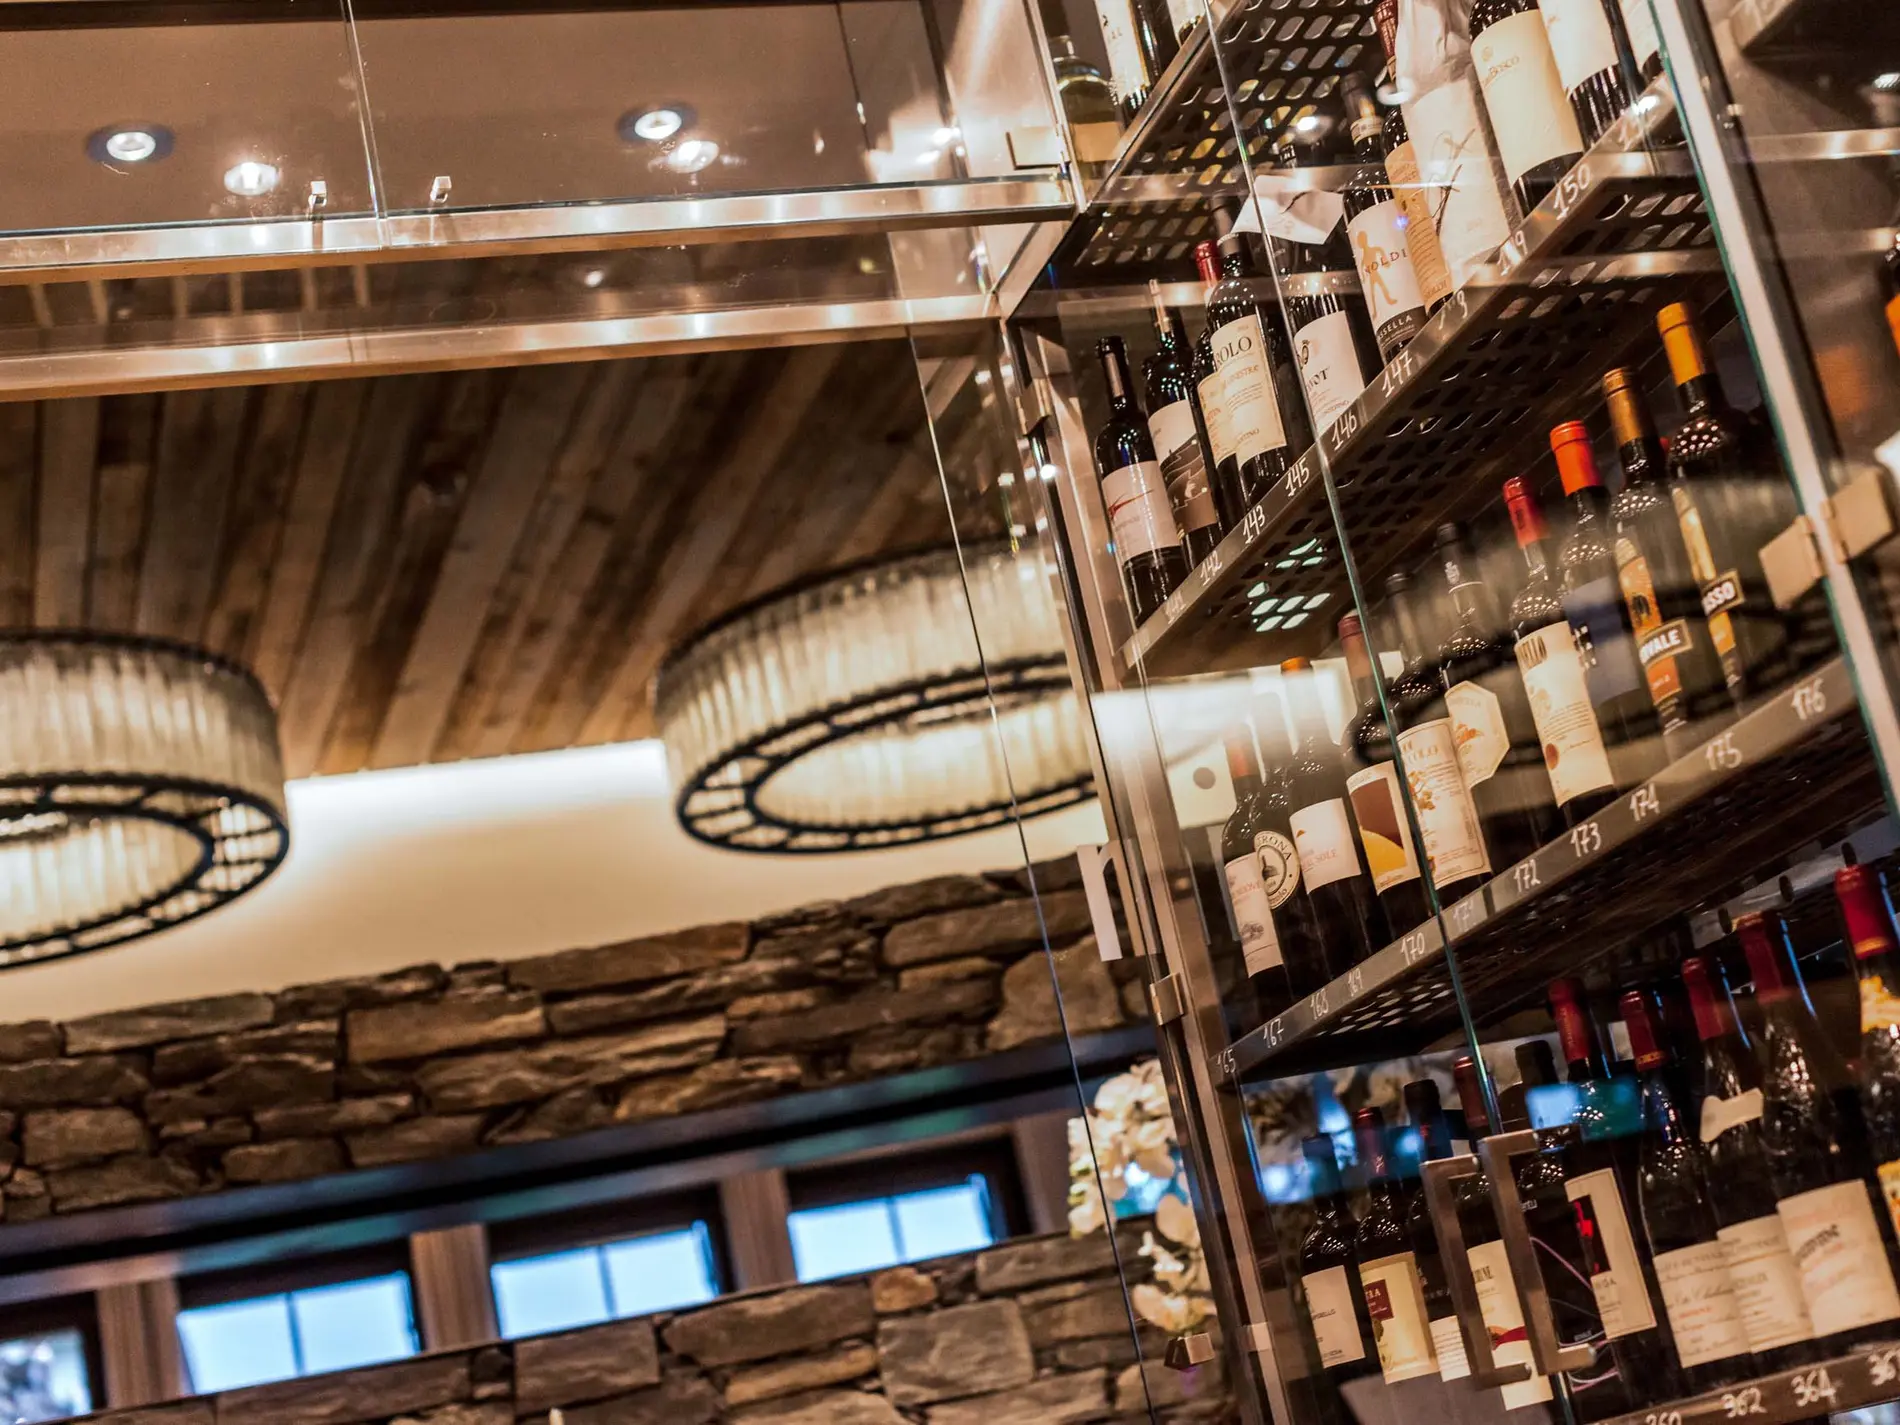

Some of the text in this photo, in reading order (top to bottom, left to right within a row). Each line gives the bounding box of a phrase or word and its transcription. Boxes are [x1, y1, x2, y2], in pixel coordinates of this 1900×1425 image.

[1553, 163, 1591, 221] 150
[1382, 350, 1412, 398] 147
[1331, 410, 1357, 451] 146
[1285, 457, 1310, 497] 145
[1243, 504, 1266, 544] 143
[1200, 550, 1223, 586] 142
[1791, 678, 1826, 720] 176
[1705, 732, 1743, 771] 175
[1629, 783, 1660, 822] 174
[1570, 822, 1601, 857] 173
[1513, 859, 1541, 893] 172
[1401, 932, 1426, 966] 170
[1263, 1017, 1285, 1049] 167
[1721, 1387, 1767, 1418] 362
[1791, 1368, 1838, 1408] 364
